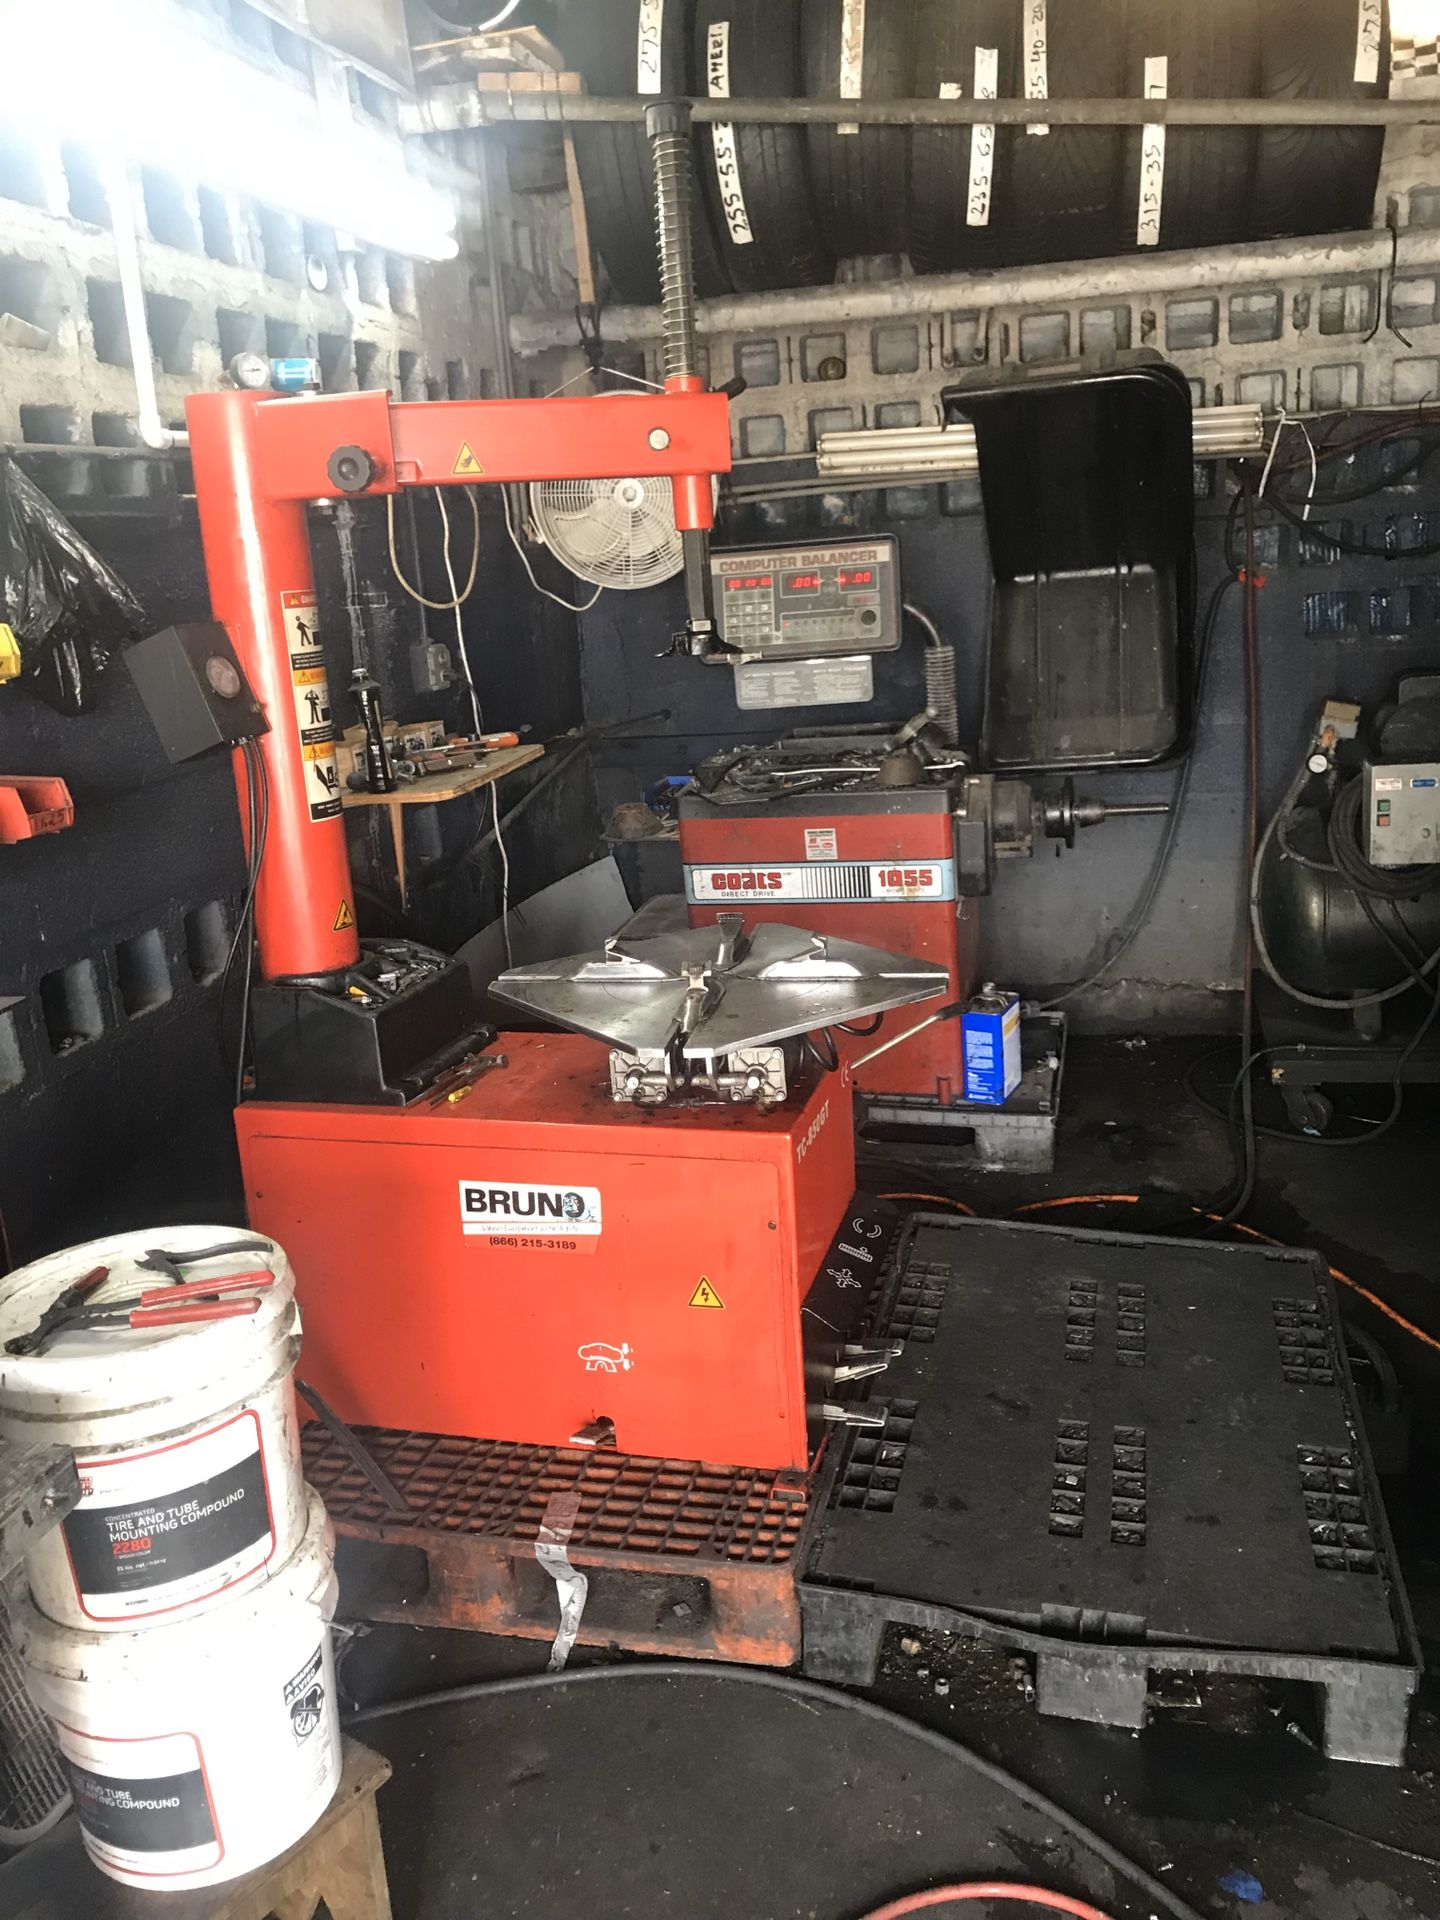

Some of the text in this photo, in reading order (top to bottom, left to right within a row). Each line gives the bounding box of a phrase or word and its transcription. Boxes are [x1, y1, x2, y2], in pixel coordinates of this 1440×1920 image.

[720, 550, 877, 573] COMPUTER BALANCER
[878, 869, 933, 887] 1055
[464, 1188, 585, 1219] BRUNO
[489, 1236, 577, 1250] (866) 215-3189
[105, 1508, 156, 1522] CONCENTRATED
[106, 1500, 200, 1533] TIRE AND TUBE
[109, 1488, 245, 1542] MOUNTING COMPOUND
[112, 1537, 152, 1555] 2280
[104, 1788, 132, 1800] TUBE
[117, 1797, 180, 1810] COMPOUND
